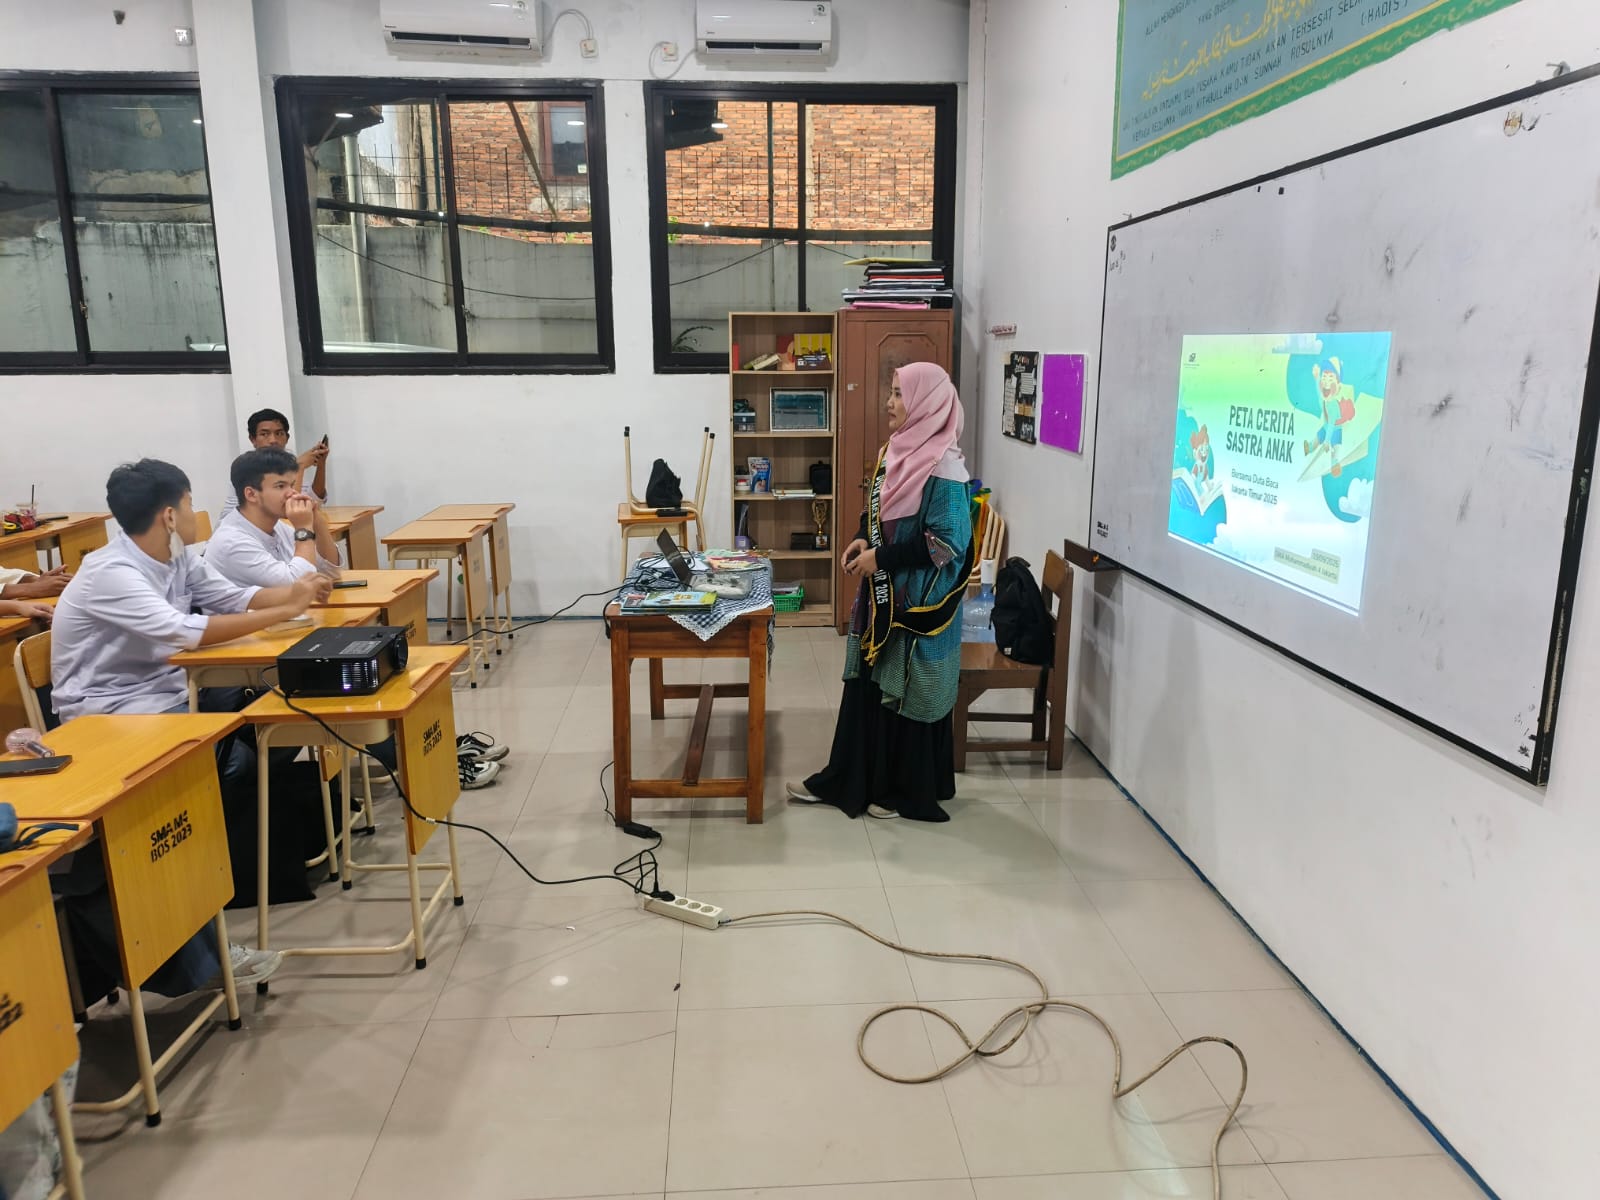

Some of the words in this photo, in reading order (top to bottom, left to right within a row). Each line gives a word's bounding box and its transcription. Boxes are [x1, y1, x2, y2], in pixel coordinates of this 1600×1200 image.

[1265, 33, 1287, 55] AKAN
[1290, 6, 1334, 42] TERSESAT
[1253, 55, 1282, 81] SUNNAH
[1290, 27, 1334, 62] ROSULNYA
[1228, 404, 1254, 430] PETA
[1255, 407, 1295, 437] CERITA
[1225, 430, 1263, 459] SASTRA
[1264, 436, 1295, 465] ANAK
[1248, 488, 1263, 502] Timur
[1263, 492, 1278, 506] 2025
[1252, 473, 1265, 487] Duta
[1265, 476, 1279, 490] Baca
[874, 583, 889, 605] 2025
[150, 822, 174, 848] SMA
[150, 839, 170, 863] BOS
[171, 823, 192, 848] 2023
